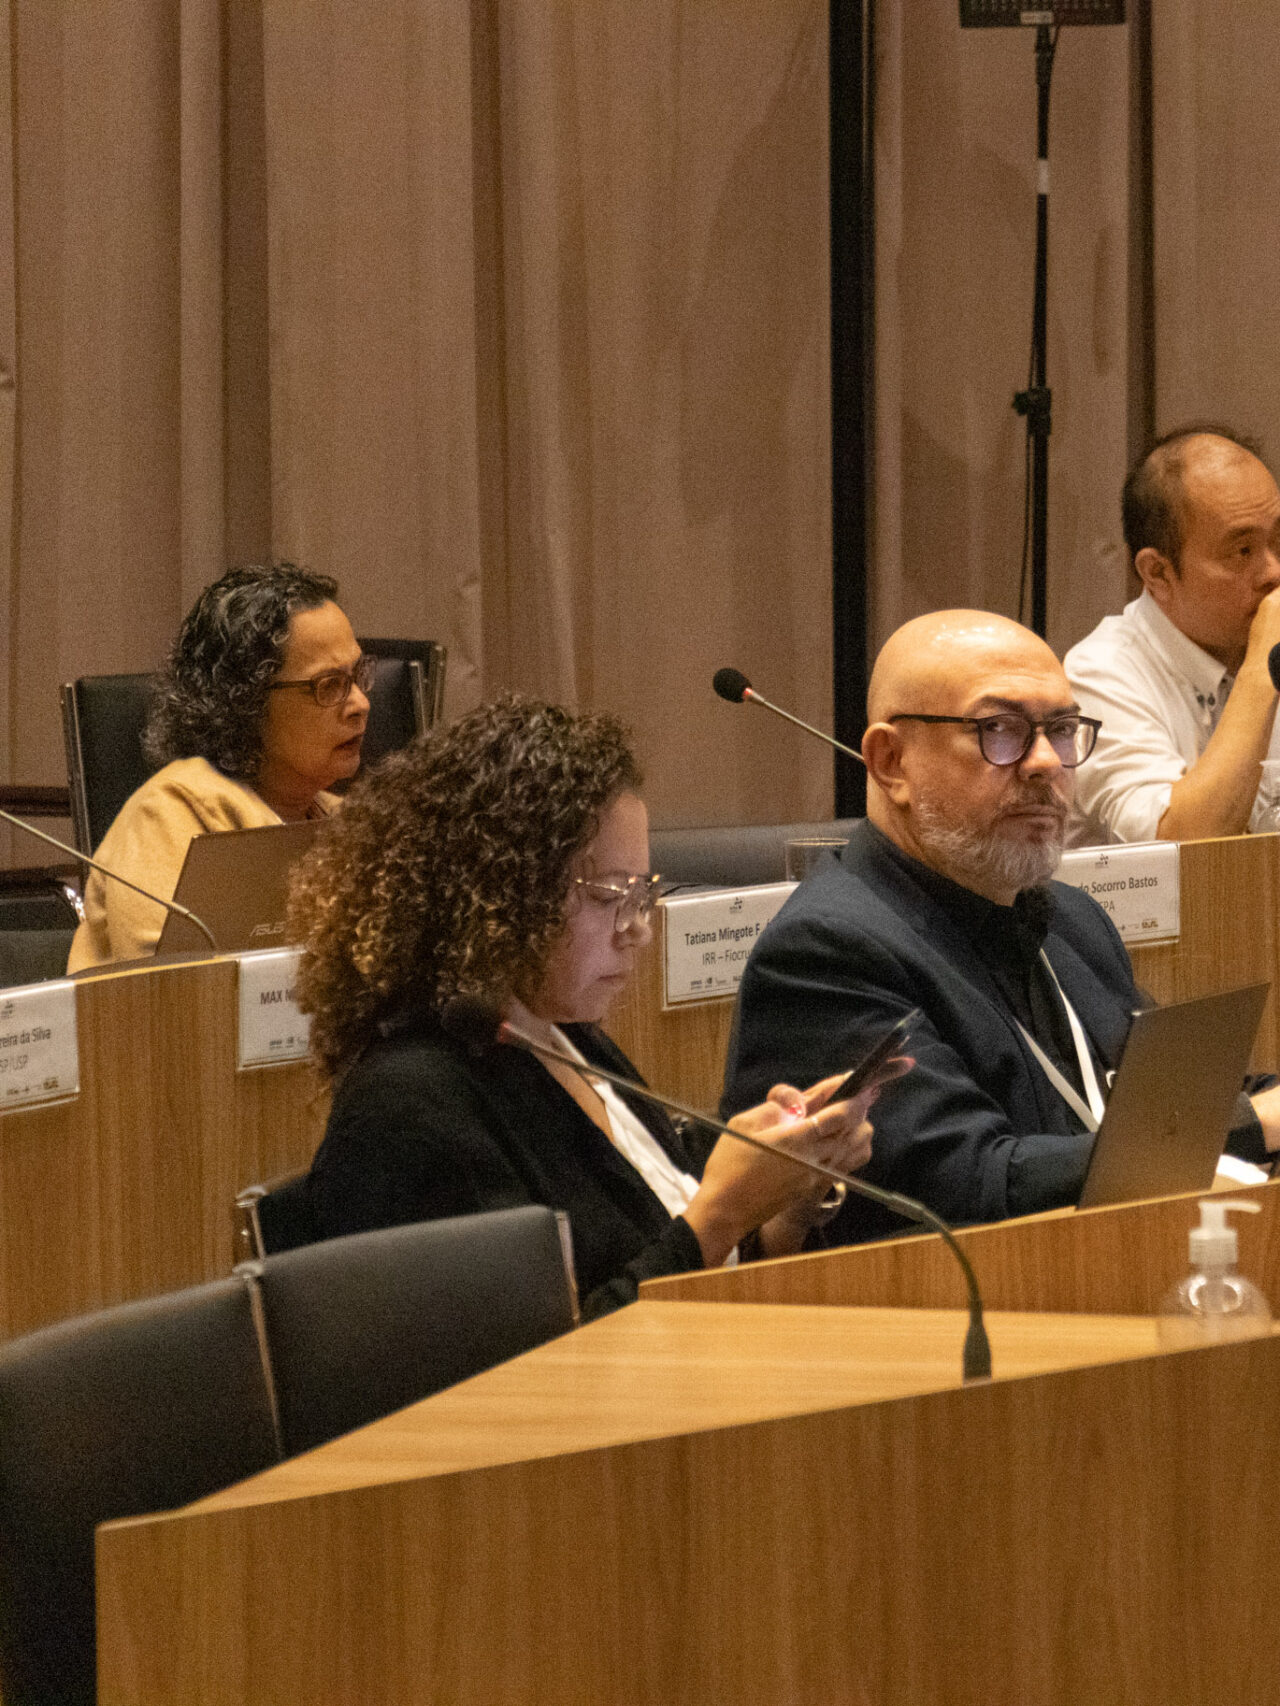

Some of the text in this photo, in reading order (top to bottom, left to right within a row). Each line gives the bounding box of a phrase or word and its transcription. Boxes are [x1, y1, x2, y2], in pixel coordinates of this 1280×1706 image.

[1091, 880, 1126, 894] Socorro
[1128, 877, 1158, 889] Bastos
[685, 931, 717, 945] Tatiana
[719, 925, 753, 941] Mingote
[702, 952, 716, 965] IRR
[260, 990, 283, 1005] MAX
[31, 1026, 51, 1042] Silva
